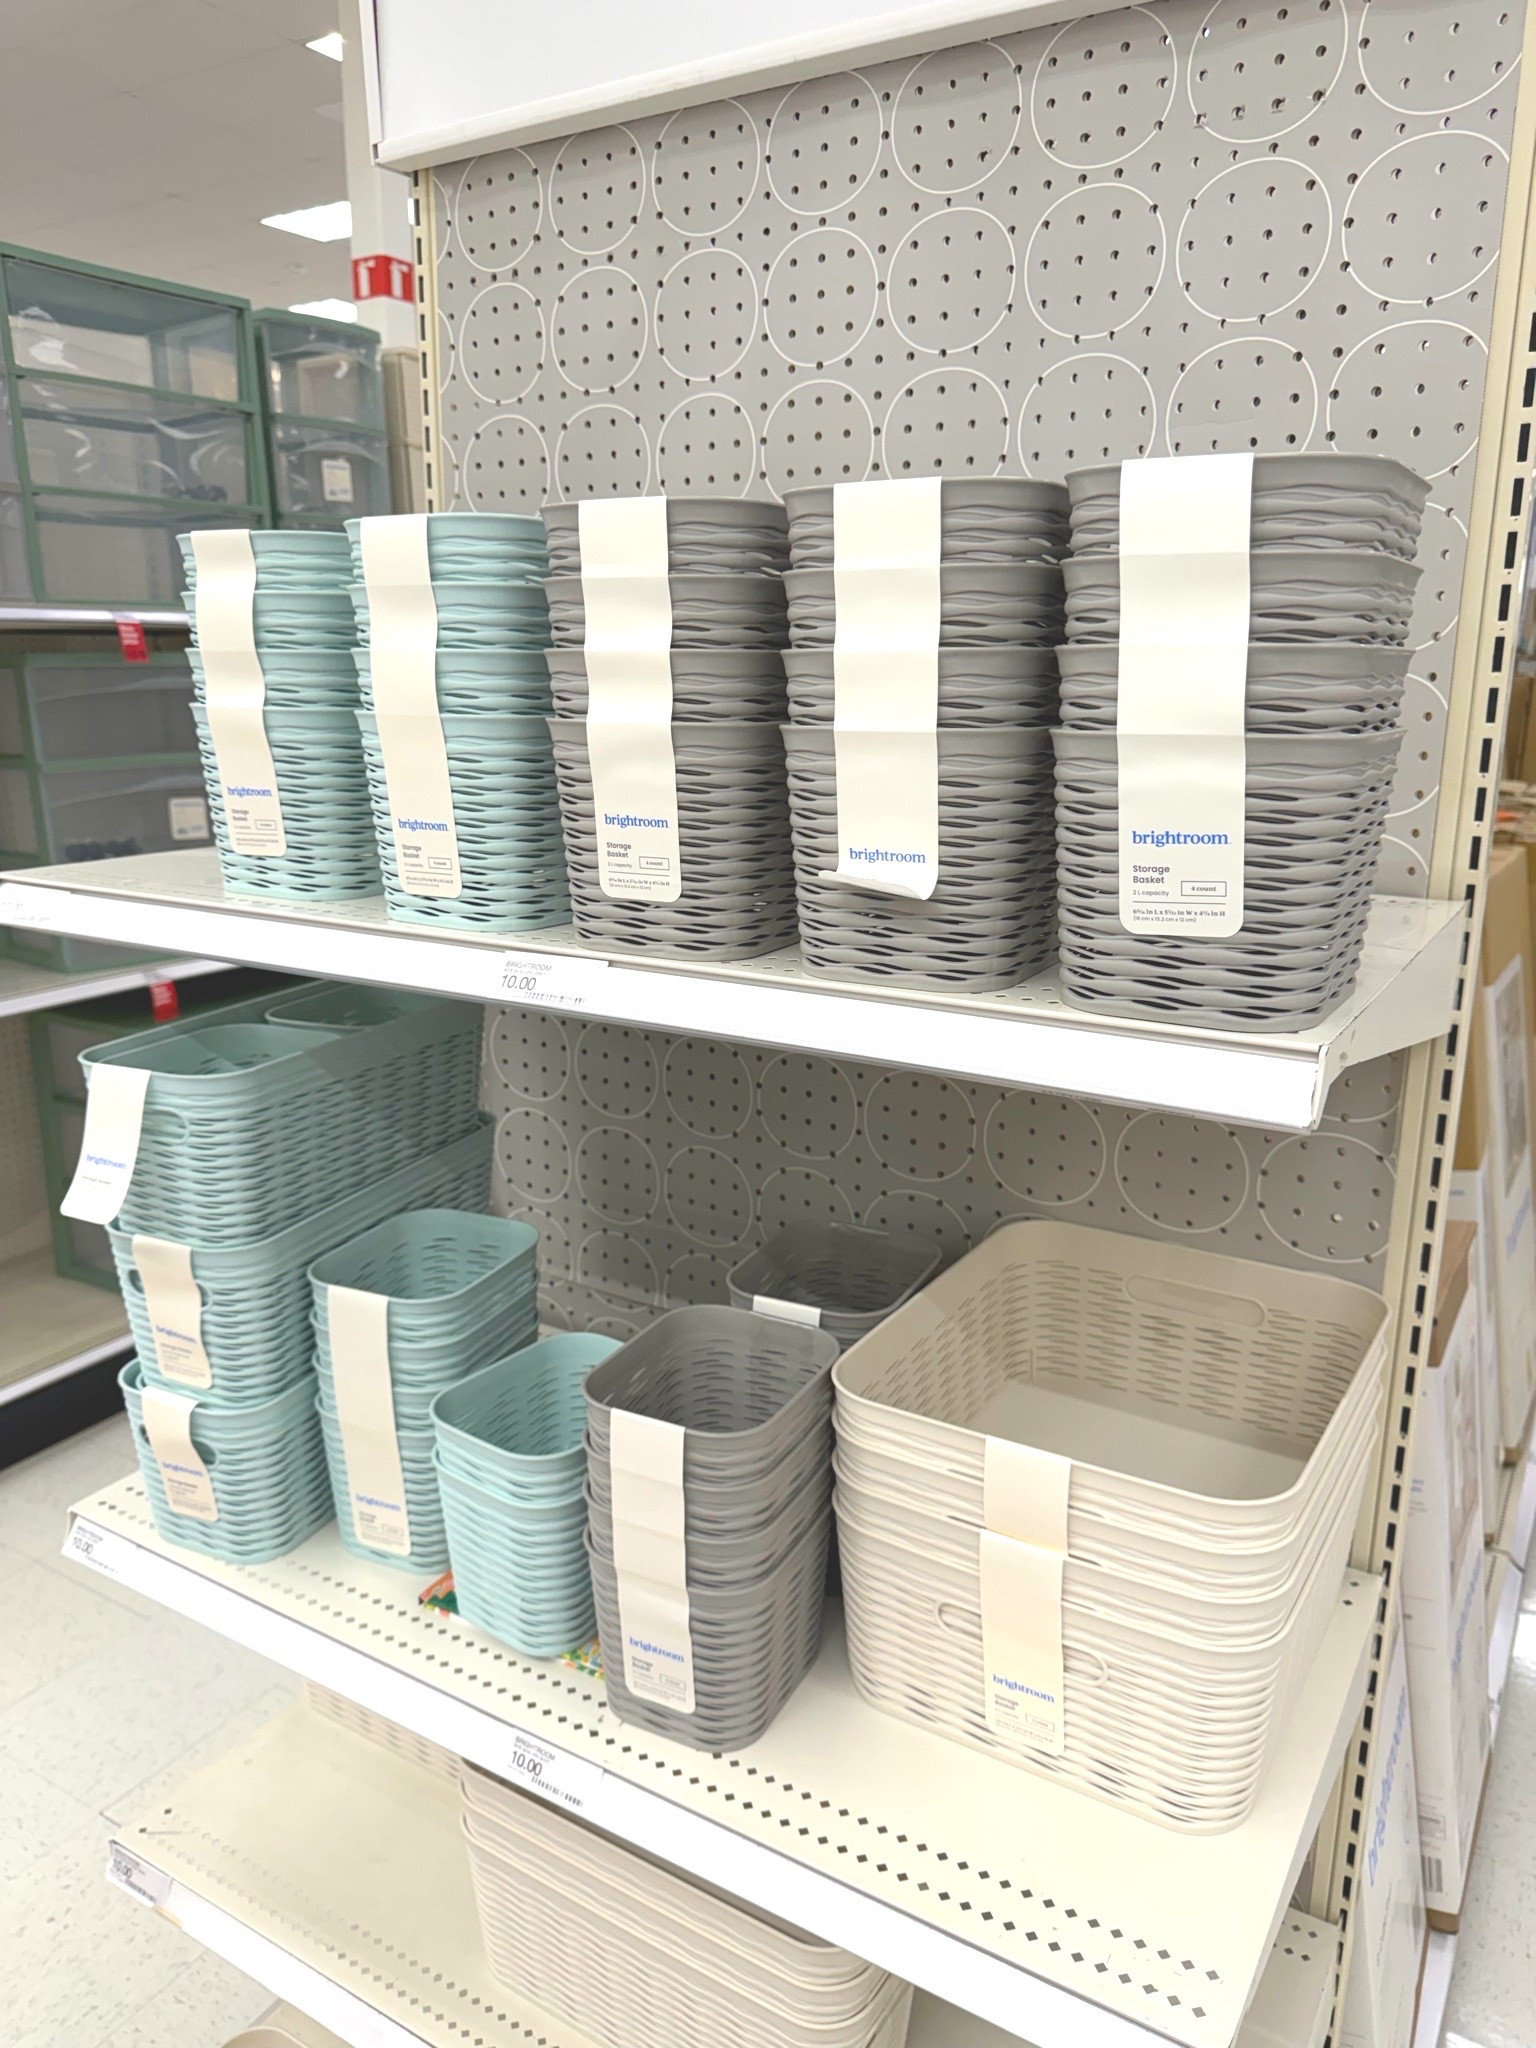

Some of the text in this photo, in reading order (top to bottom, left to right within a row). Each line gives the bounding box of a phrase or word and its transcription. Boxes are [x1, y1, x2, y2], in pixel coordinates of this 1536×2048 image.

[227, 786, 273, 798] brightroom
[398, 818, 449, 832] brightroom
[604, 813, 669, 829] brightroom
[1131, 830, 1229, 848] brightroom
[606, 842, 632, 851] Storage
[607, 850, 629, 858] Basket
[849, 847, 926, 863] brightroom
[1132, 865, 1170, 875] Storage
[1132, 875, 1165, 884] Basket
[1141, 889, 1170, 897] capacity
[505, 960, 553, 972] BRIGHTROOM
[501, 974, 537, 991] 10.00
[629, 1635, 685, 1663] brightroom
[992, 1673, 1055, 1703] brightroom
[511, 1750, 543, 1777] 10.00
